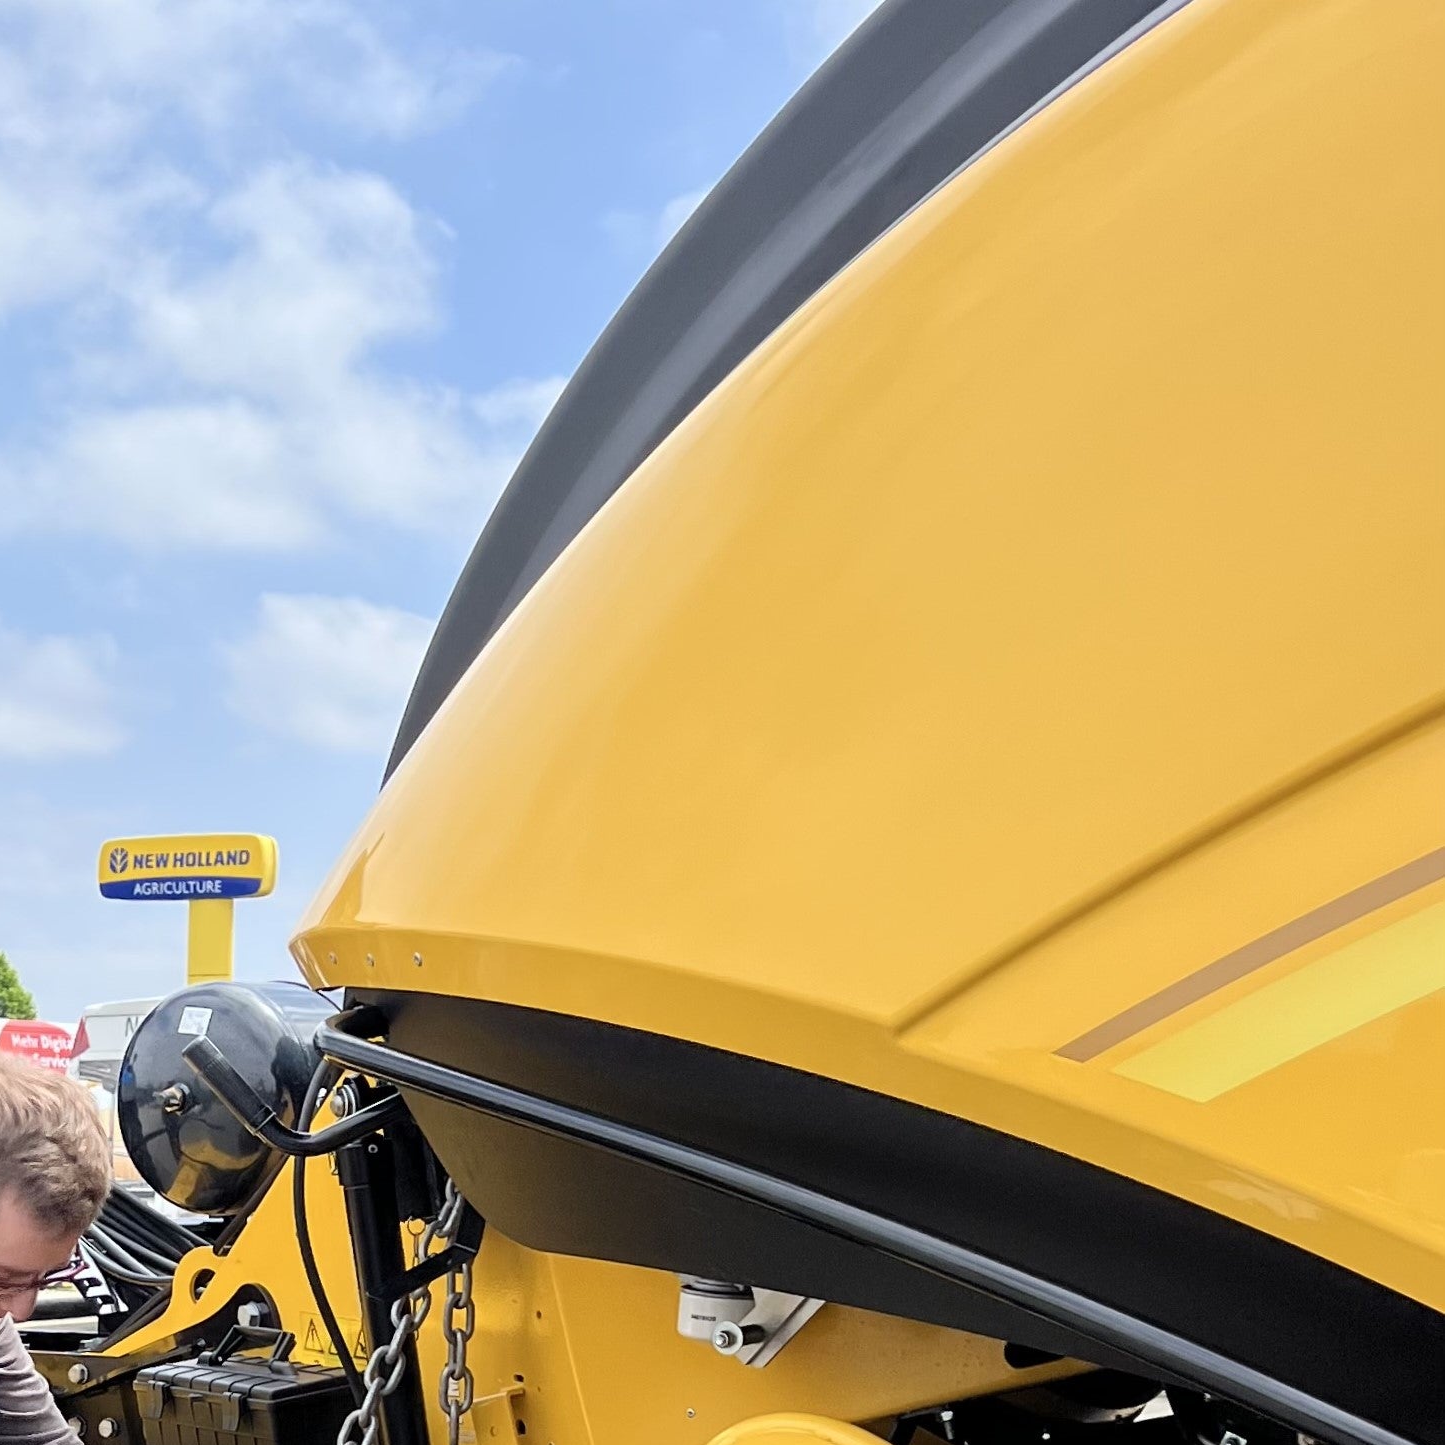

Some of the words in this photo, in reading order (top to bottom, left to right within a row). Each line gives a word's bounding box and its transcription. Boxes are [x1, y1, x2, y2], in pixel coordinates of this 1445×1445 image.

[133, 853, 170, 870] NEW
[173, 849, 251, 868] HOLLAND
[133, 879, 223, 896] AGRICULTURE
